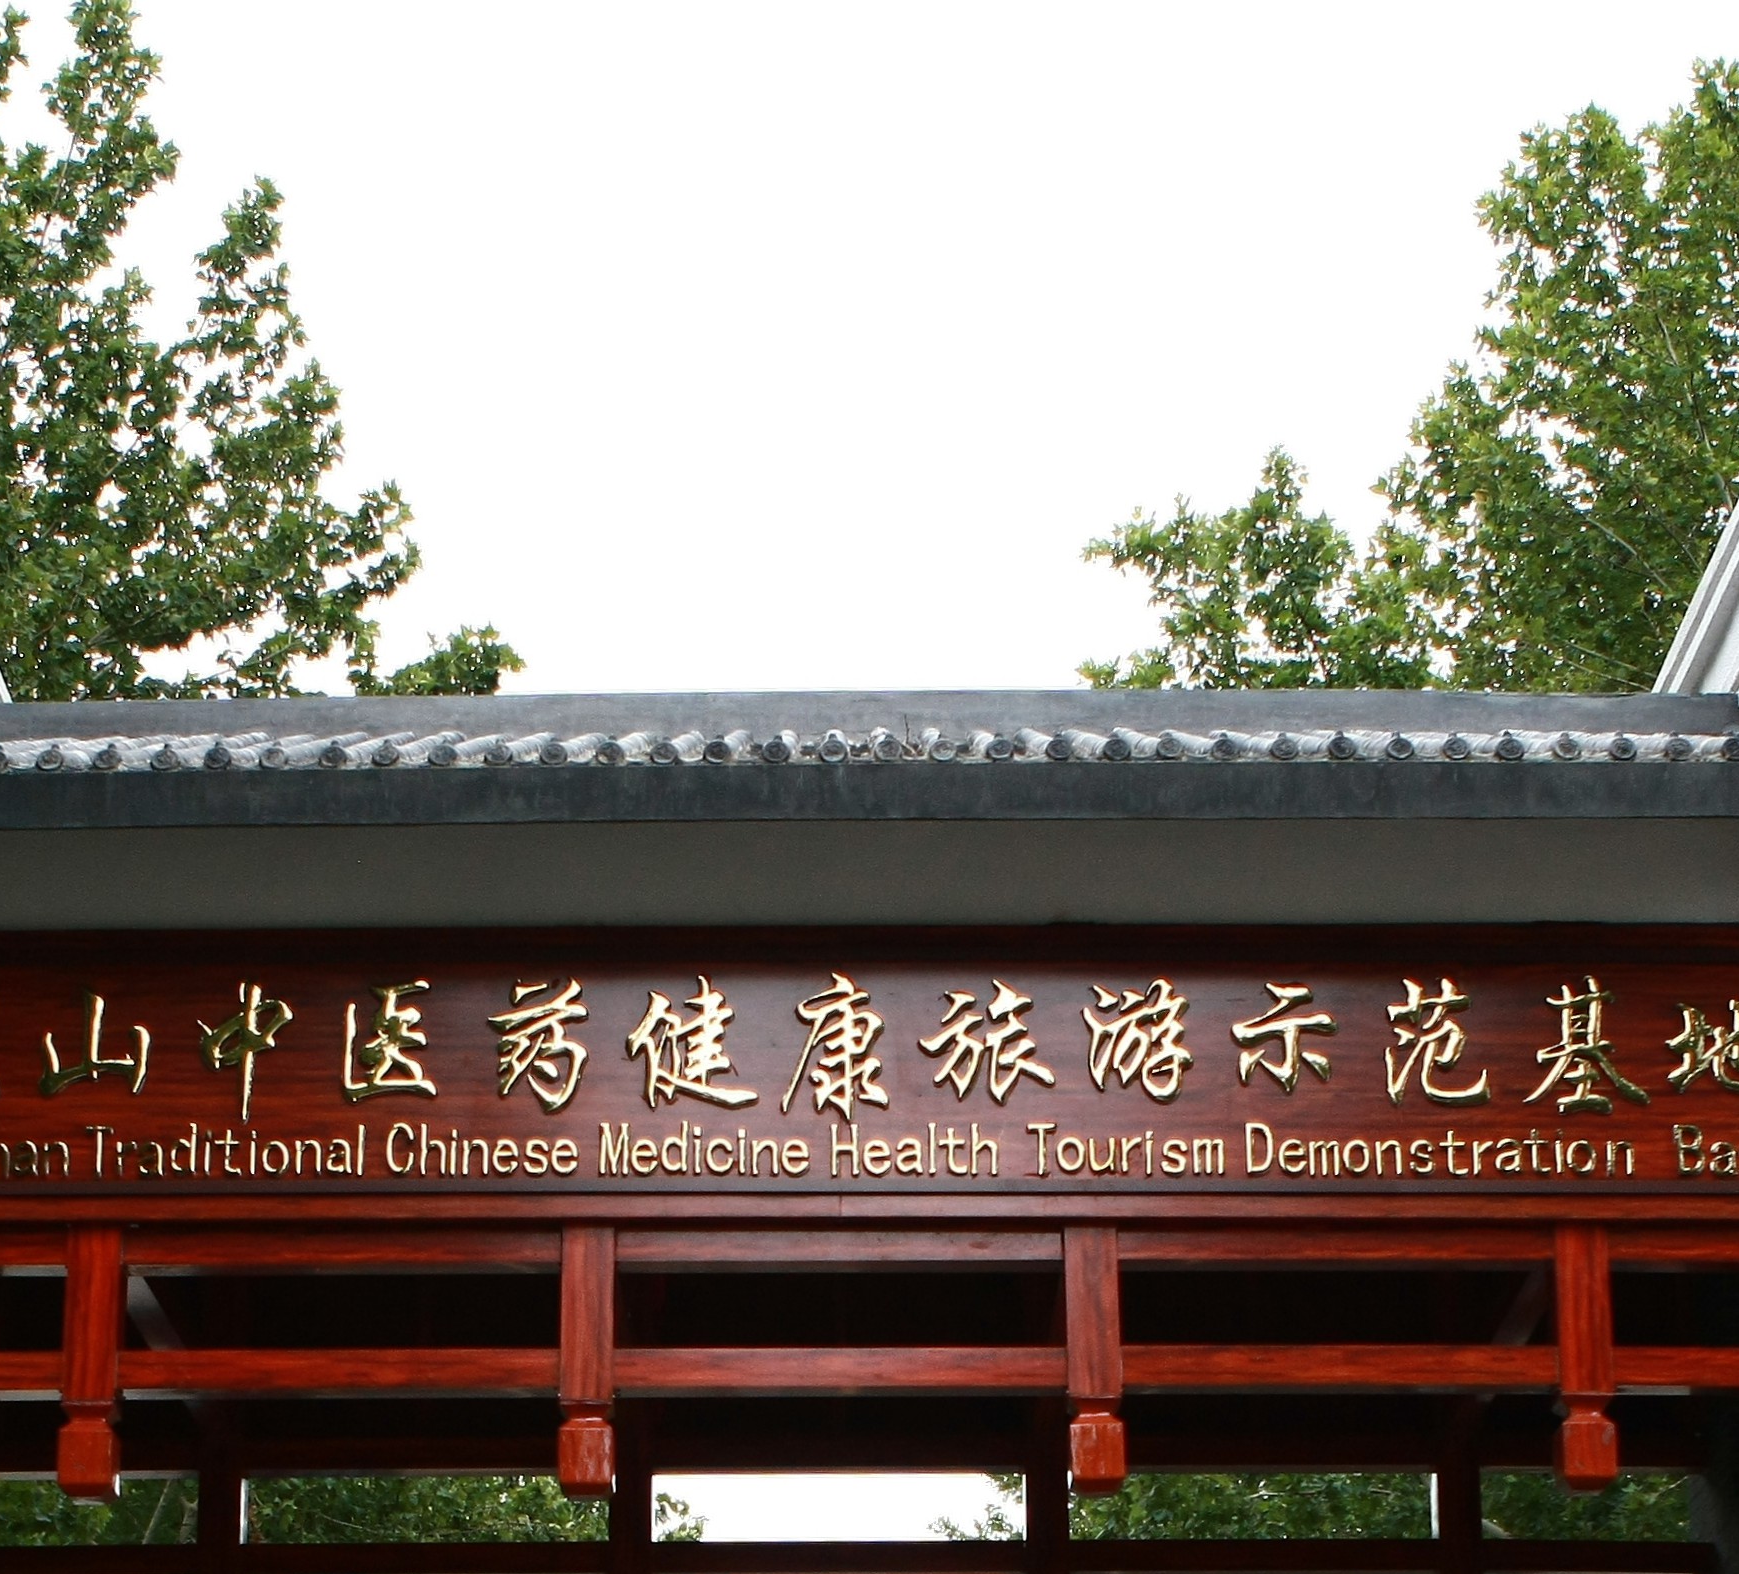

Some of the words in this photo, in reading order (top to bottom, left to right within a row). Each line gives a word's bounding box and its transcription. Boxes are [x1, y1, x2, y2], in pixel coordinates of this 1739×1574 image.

[85, 1121, 367, 1177] Traditional
[385, 1121, 580, 1177] Chinese
[598, 1119, 811, 1177] Medicine
[829, 1121, 1000, 1177] Health
[1025, 1121, 1227, 1176] Tourism
[1244, 1121, 1637, 1177] Demonstration
